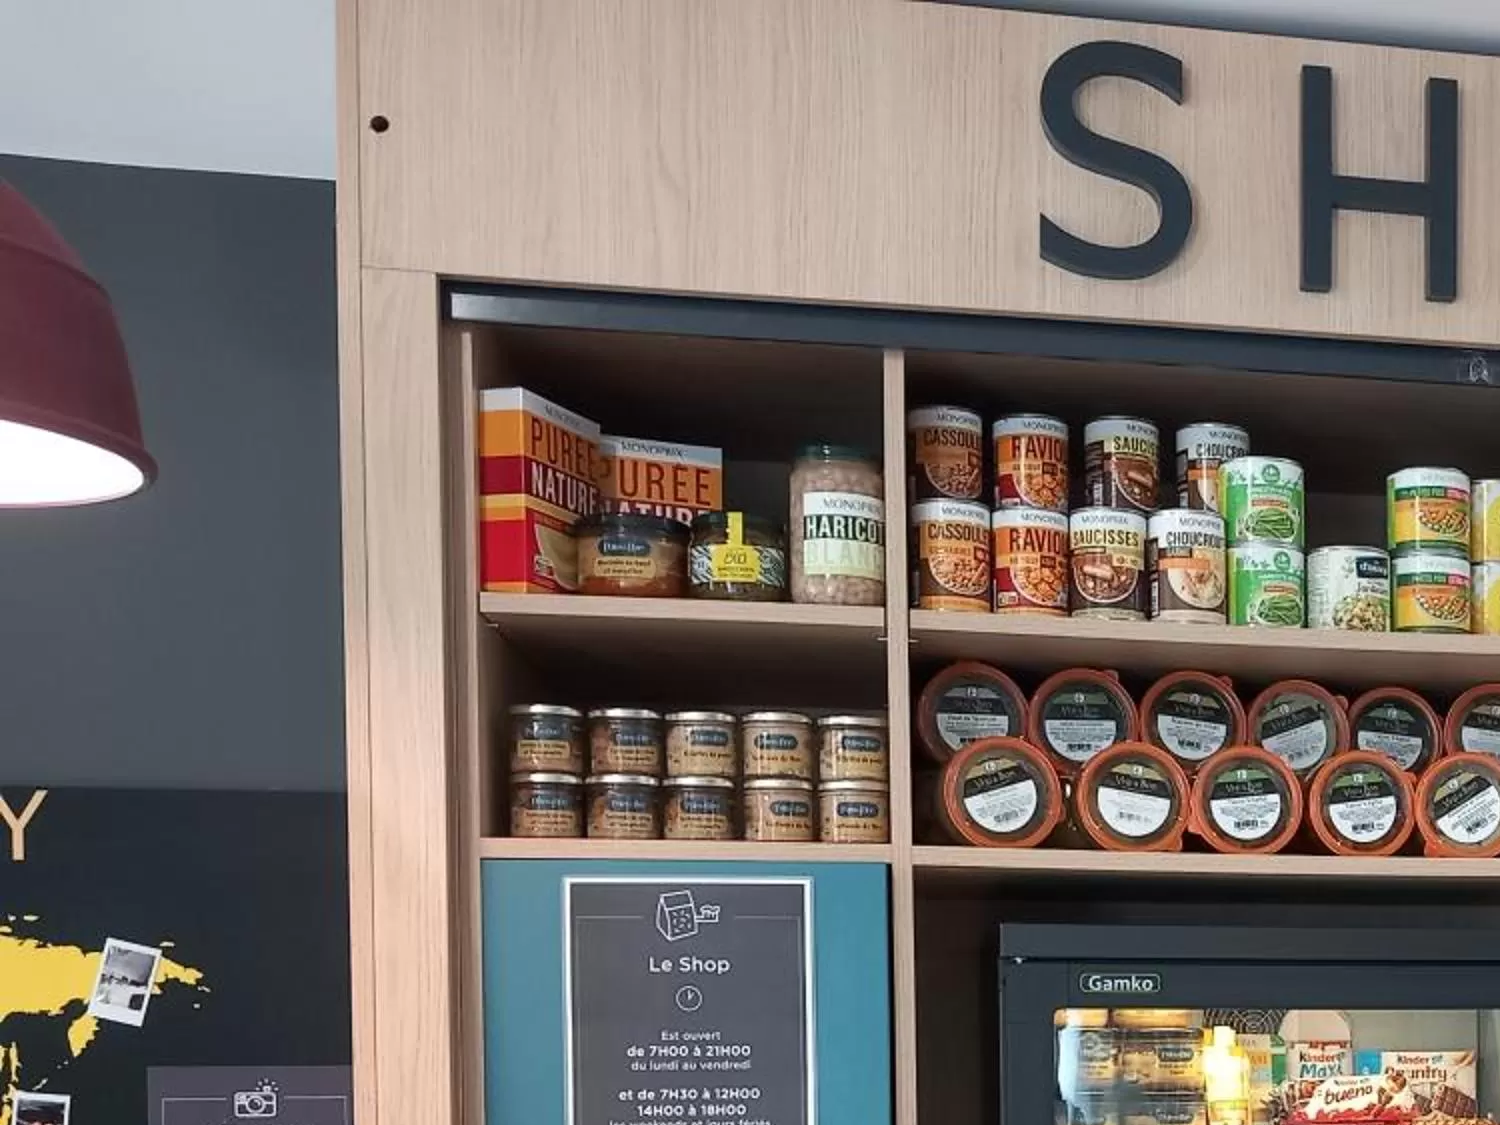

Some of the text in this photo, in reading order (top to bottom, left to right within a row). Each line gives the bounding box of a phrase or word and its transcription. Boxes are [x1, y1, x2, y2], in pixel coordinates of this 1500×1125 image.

[532, 461, 599, 516] NATURE
[1073, 528, 1139, 547] SAUCISSES
[649, 956, 731, 976] Le Shop
[1089, 975, 1154, 991] Gamko
[661, 1031, 721, 1041] Est ouvert
[627, 1045, 751, 1057] de 7H00 à 21H00
[631, 1060, 752, 1071] du lundi au vendredi
[619, 1087, 761, 1100] et de 7H30 à 12H00
[1325, 1085, 1373, 1104] bueno
[638, 1104, 746, 1116] 14H00 à 18H00
